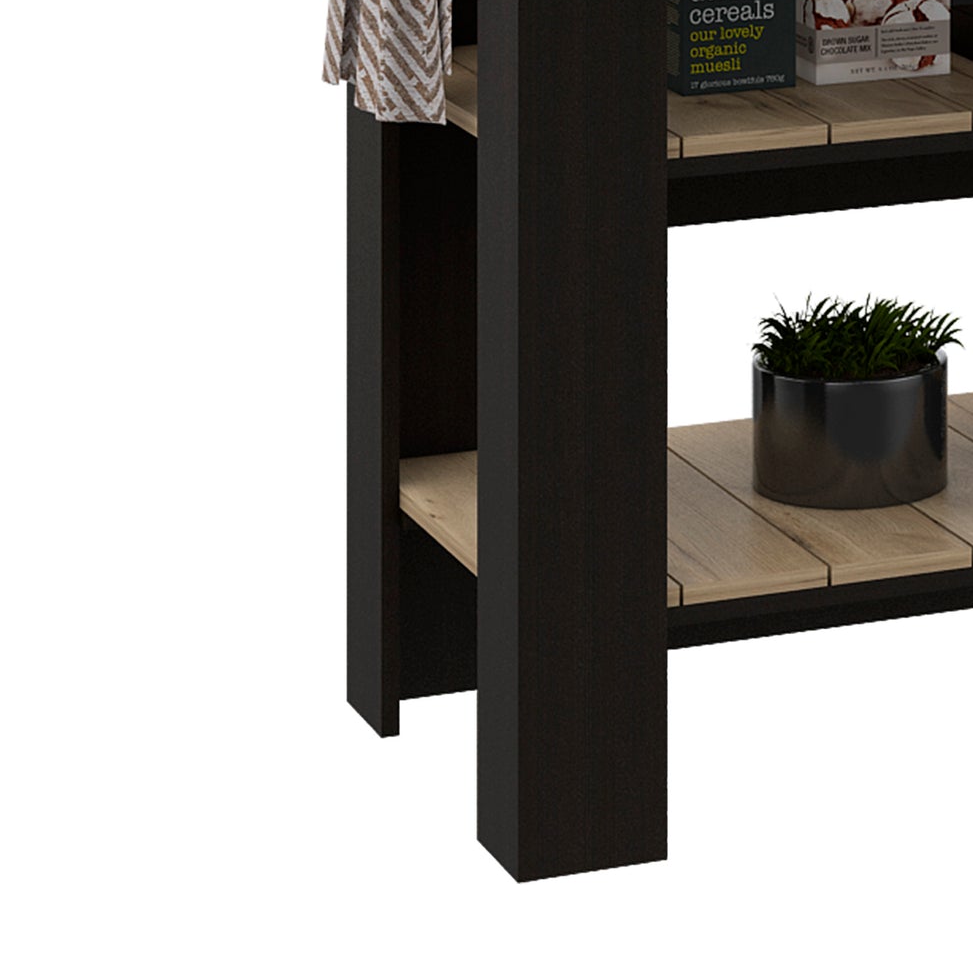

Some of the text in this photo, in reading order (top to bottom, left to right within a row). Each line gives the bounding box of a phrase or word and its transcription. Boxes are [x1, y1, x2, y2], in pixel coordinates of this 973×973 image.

[689, 0, 775, 25] cereals
[690, 24, 765, 42] our lovely
[822, 38, 847, 46] BROWN
[848, 35, 870, 45] SUGAR
[690, 41, 747, 59] organic
[820, 45, 857, 55] CHOCOLATE
[859, 44, 872, 52] MIX
[690, 57, 741, 74] muesli
